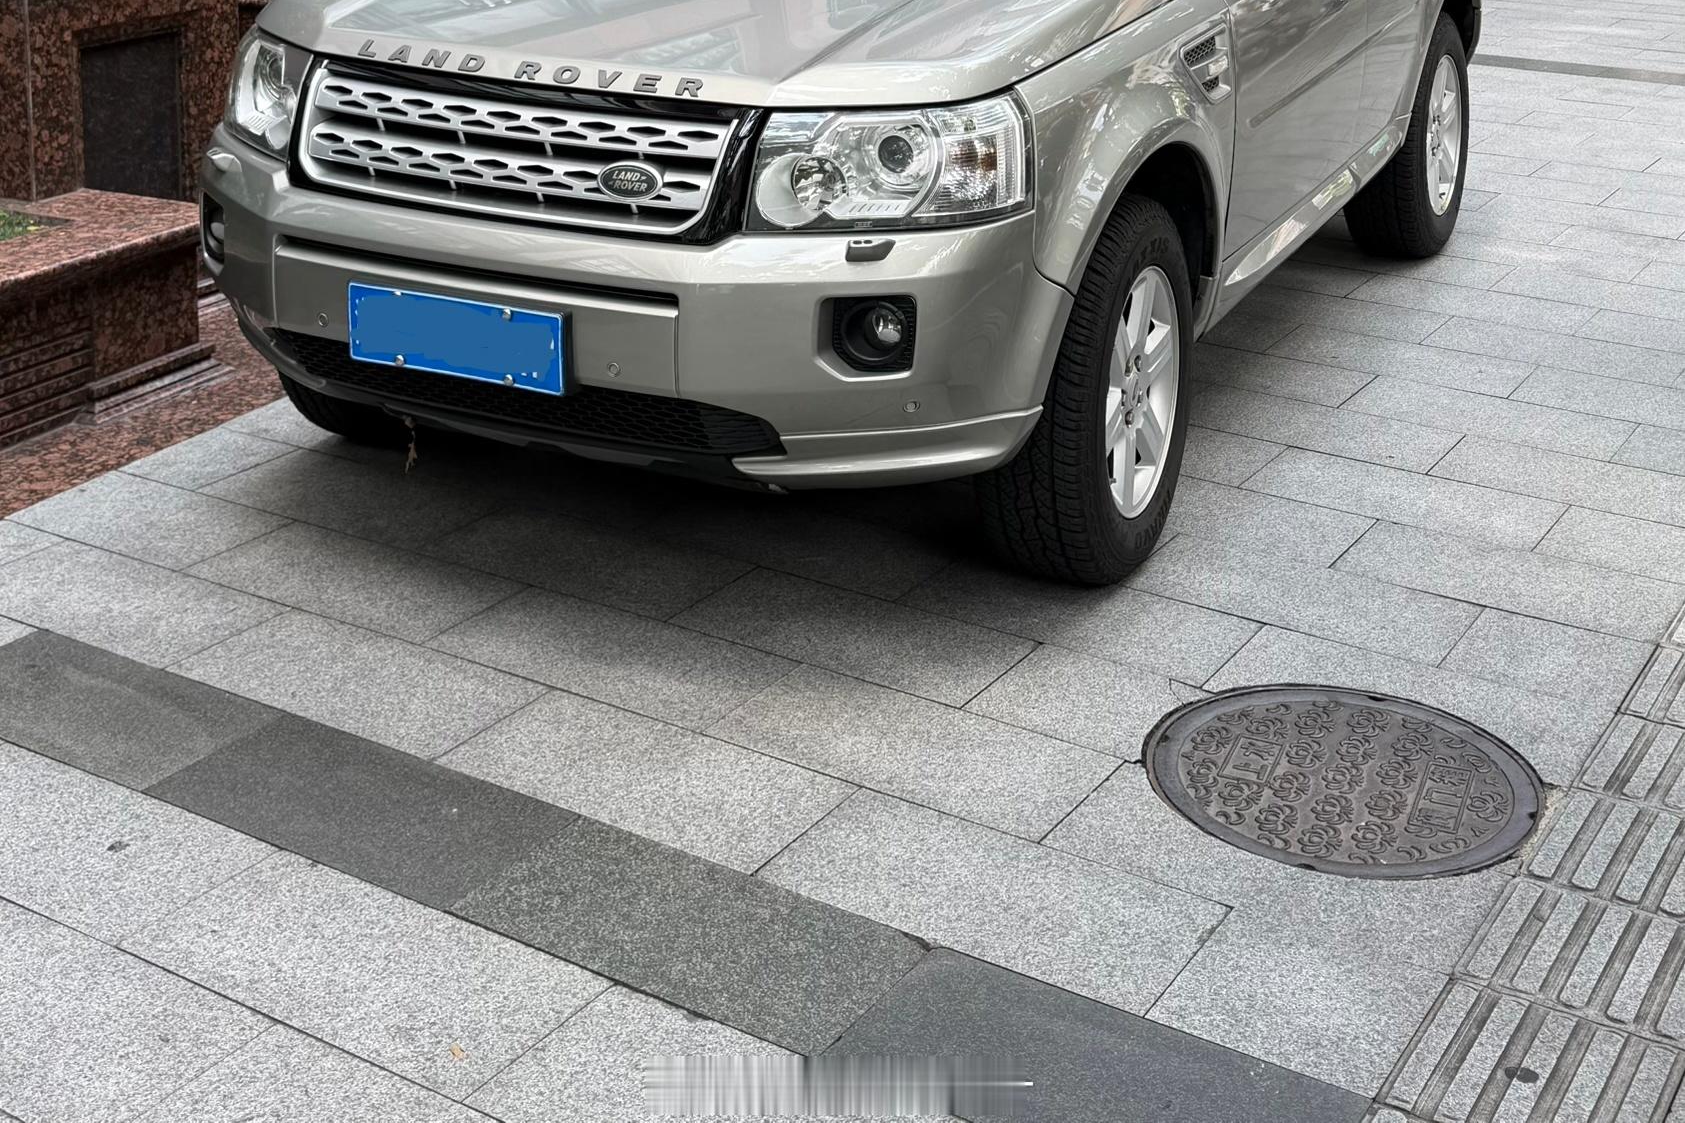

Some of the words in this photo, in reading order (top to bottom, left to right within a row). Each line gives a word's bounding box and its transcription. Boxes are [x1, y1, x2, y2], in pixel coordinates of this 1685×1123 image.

[358, 39, 486, 73] LAND
[514, 60, 704, 98] ROVER
[612, 170, 641, 181] LAND
[613, 180, 648, 192] ROVER
